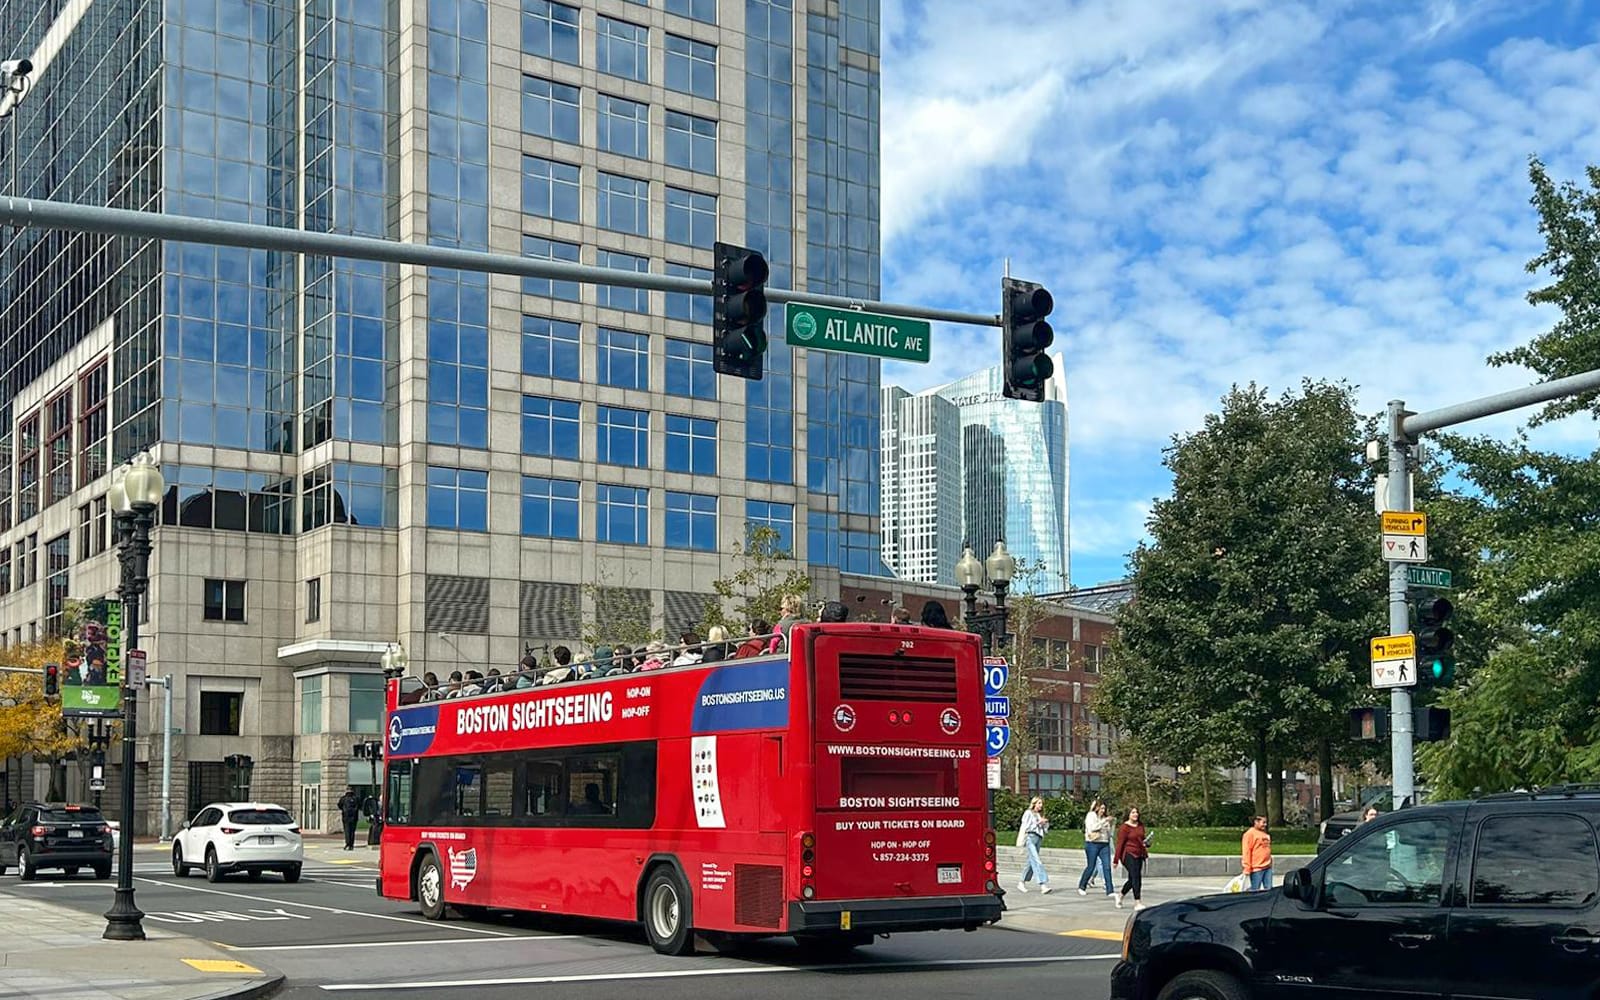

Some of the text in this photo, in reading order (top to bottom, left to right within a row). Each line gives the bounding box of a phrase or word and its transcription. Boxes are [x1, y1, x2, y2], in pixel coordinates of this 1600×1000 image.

[824, 317, 923, 352] ATLANTIC AVE
[1397, 544, 1406, 552] TO
[1407, 568, 1443, 585] ATLANTIC
[106, 602, 120, 683] EXPLORE
[626, 686, 651, 699] HOP-ON
[701, 687, 785, 706] BOSTONSIGHTSEEING.US
[456, 690, 613, 735] BOSTON SIGHTSEEING
[622, 705, 651, 719] HOP-OFF
[985, 701, 1006, 714] OUTH
[827, 745, 971, 759] WWW.BOSTONSIGHTSEEING.US
[839, 796, 960, 808] BOSTON SIGHTSEEING
[835, 819, 965, 830] BUY YOUR TICKETS ON BOARD
[870, 840, 886, 849] HOP
[886, 840, 898, 849] ON
[902, 840, 917, 849] HOP
[917, 840, 931, 848] OFF
[879, 853, 930, 862] 857-234-3375
[1275, 975, 1313, 983] YUKON
